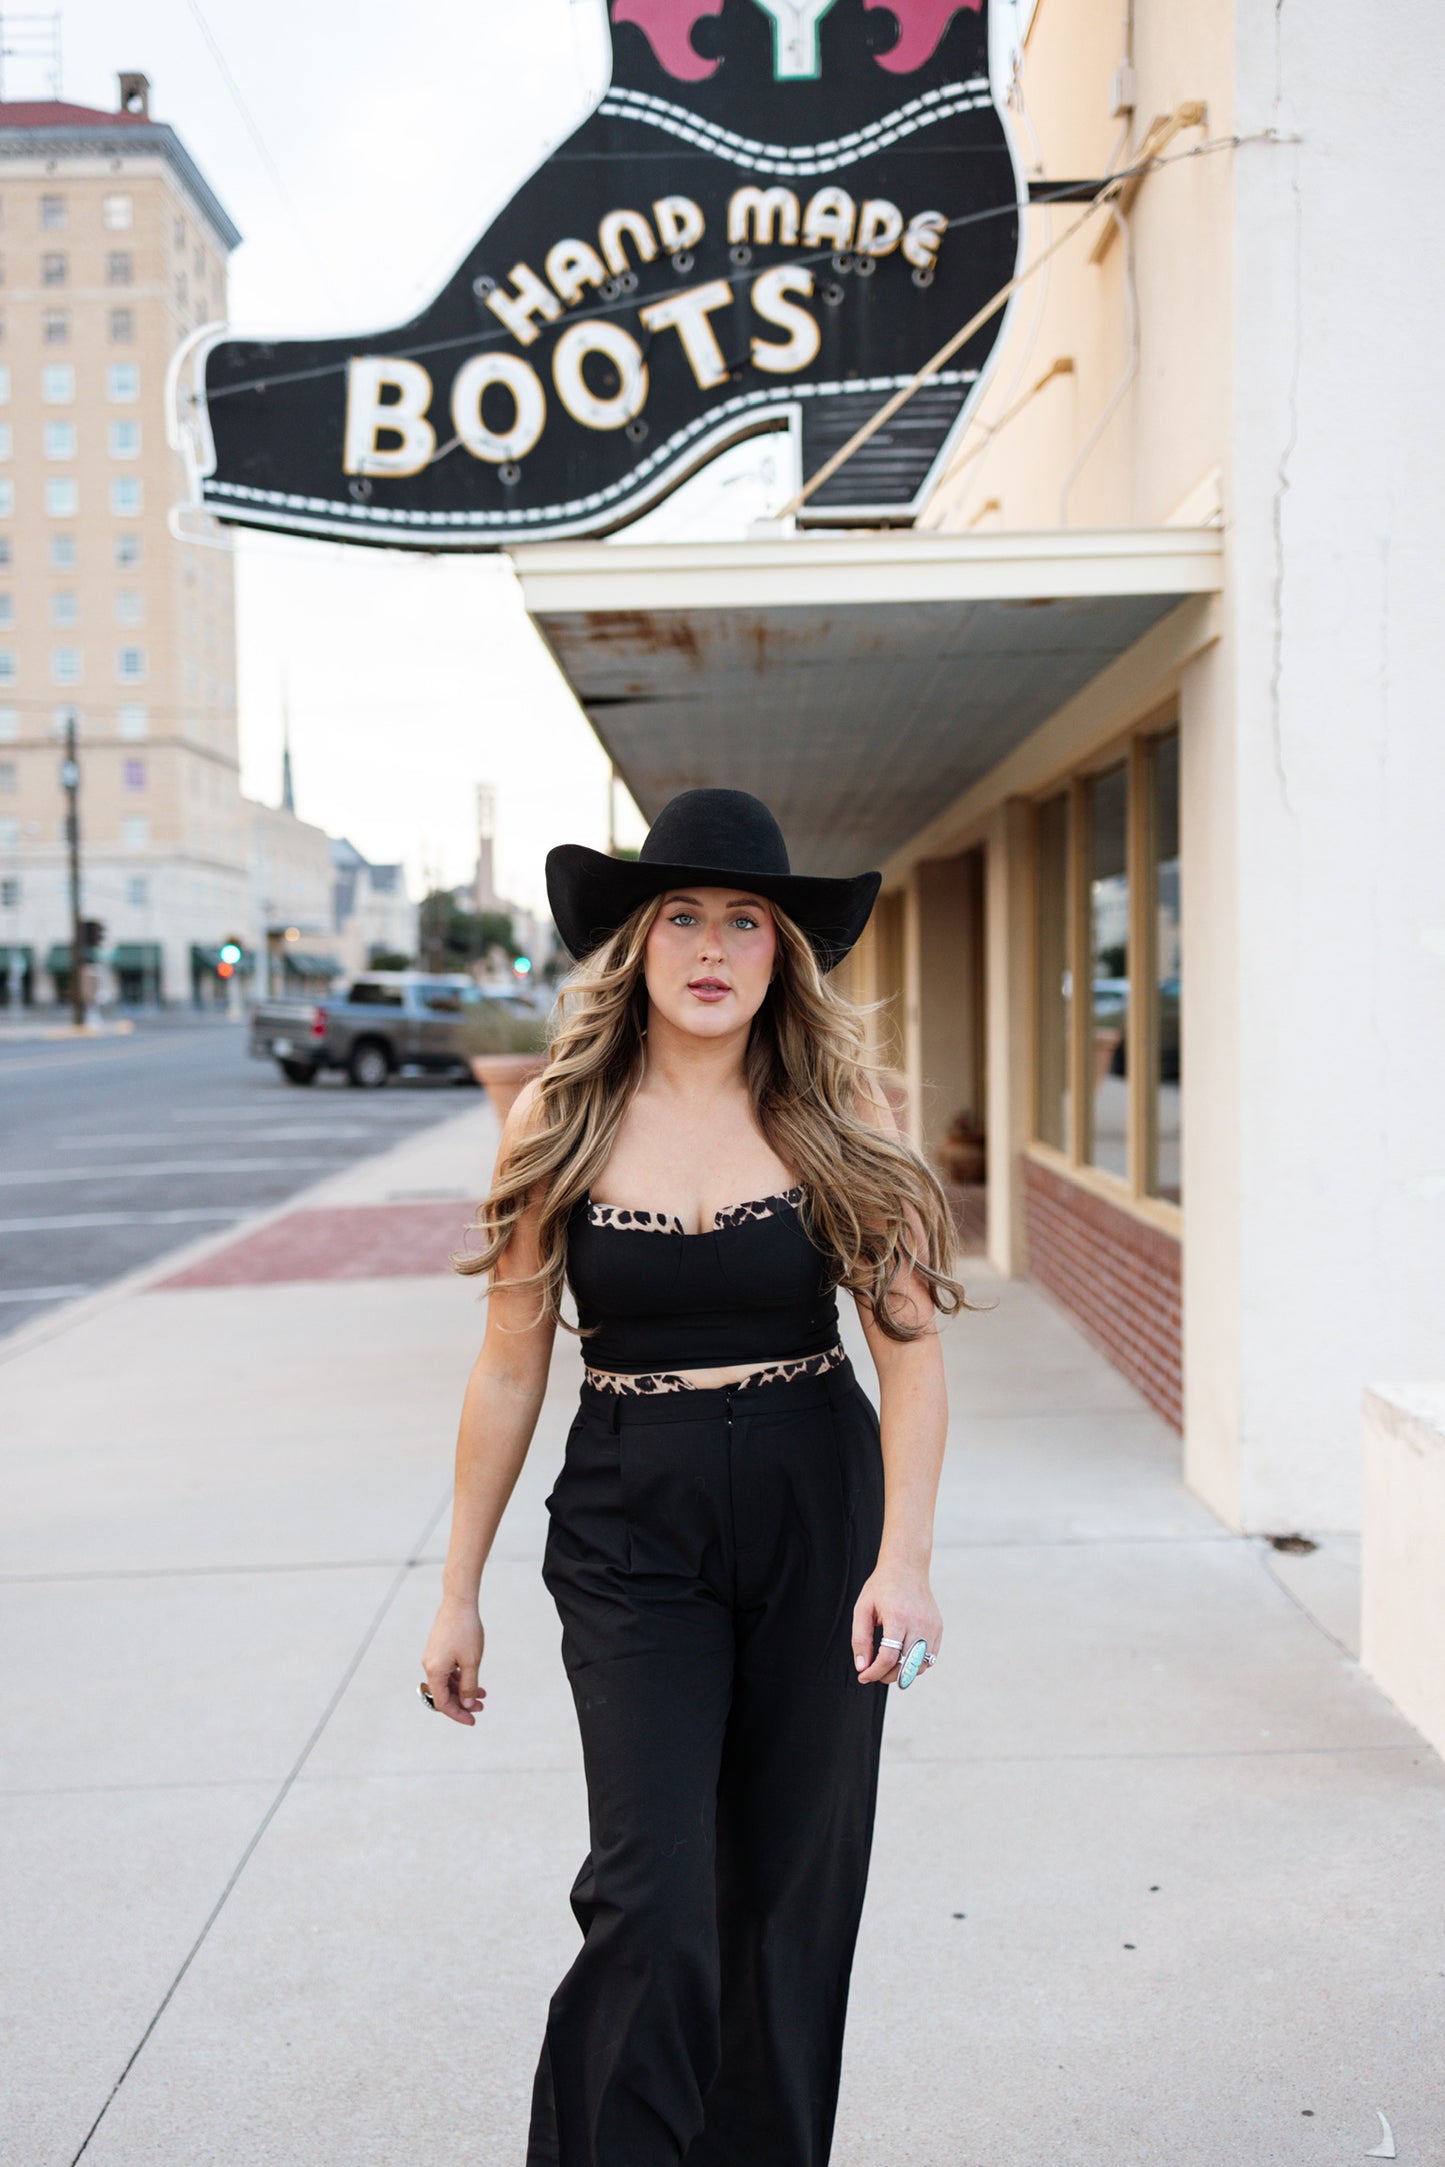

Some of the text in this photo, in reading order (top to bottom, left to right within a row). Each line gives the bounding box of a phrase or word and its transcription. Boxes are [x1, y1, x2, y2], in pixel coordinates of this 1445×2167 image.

[486, 186, 948, 346] HAND MADE
[343, 265, 821, 477] BOOTS
